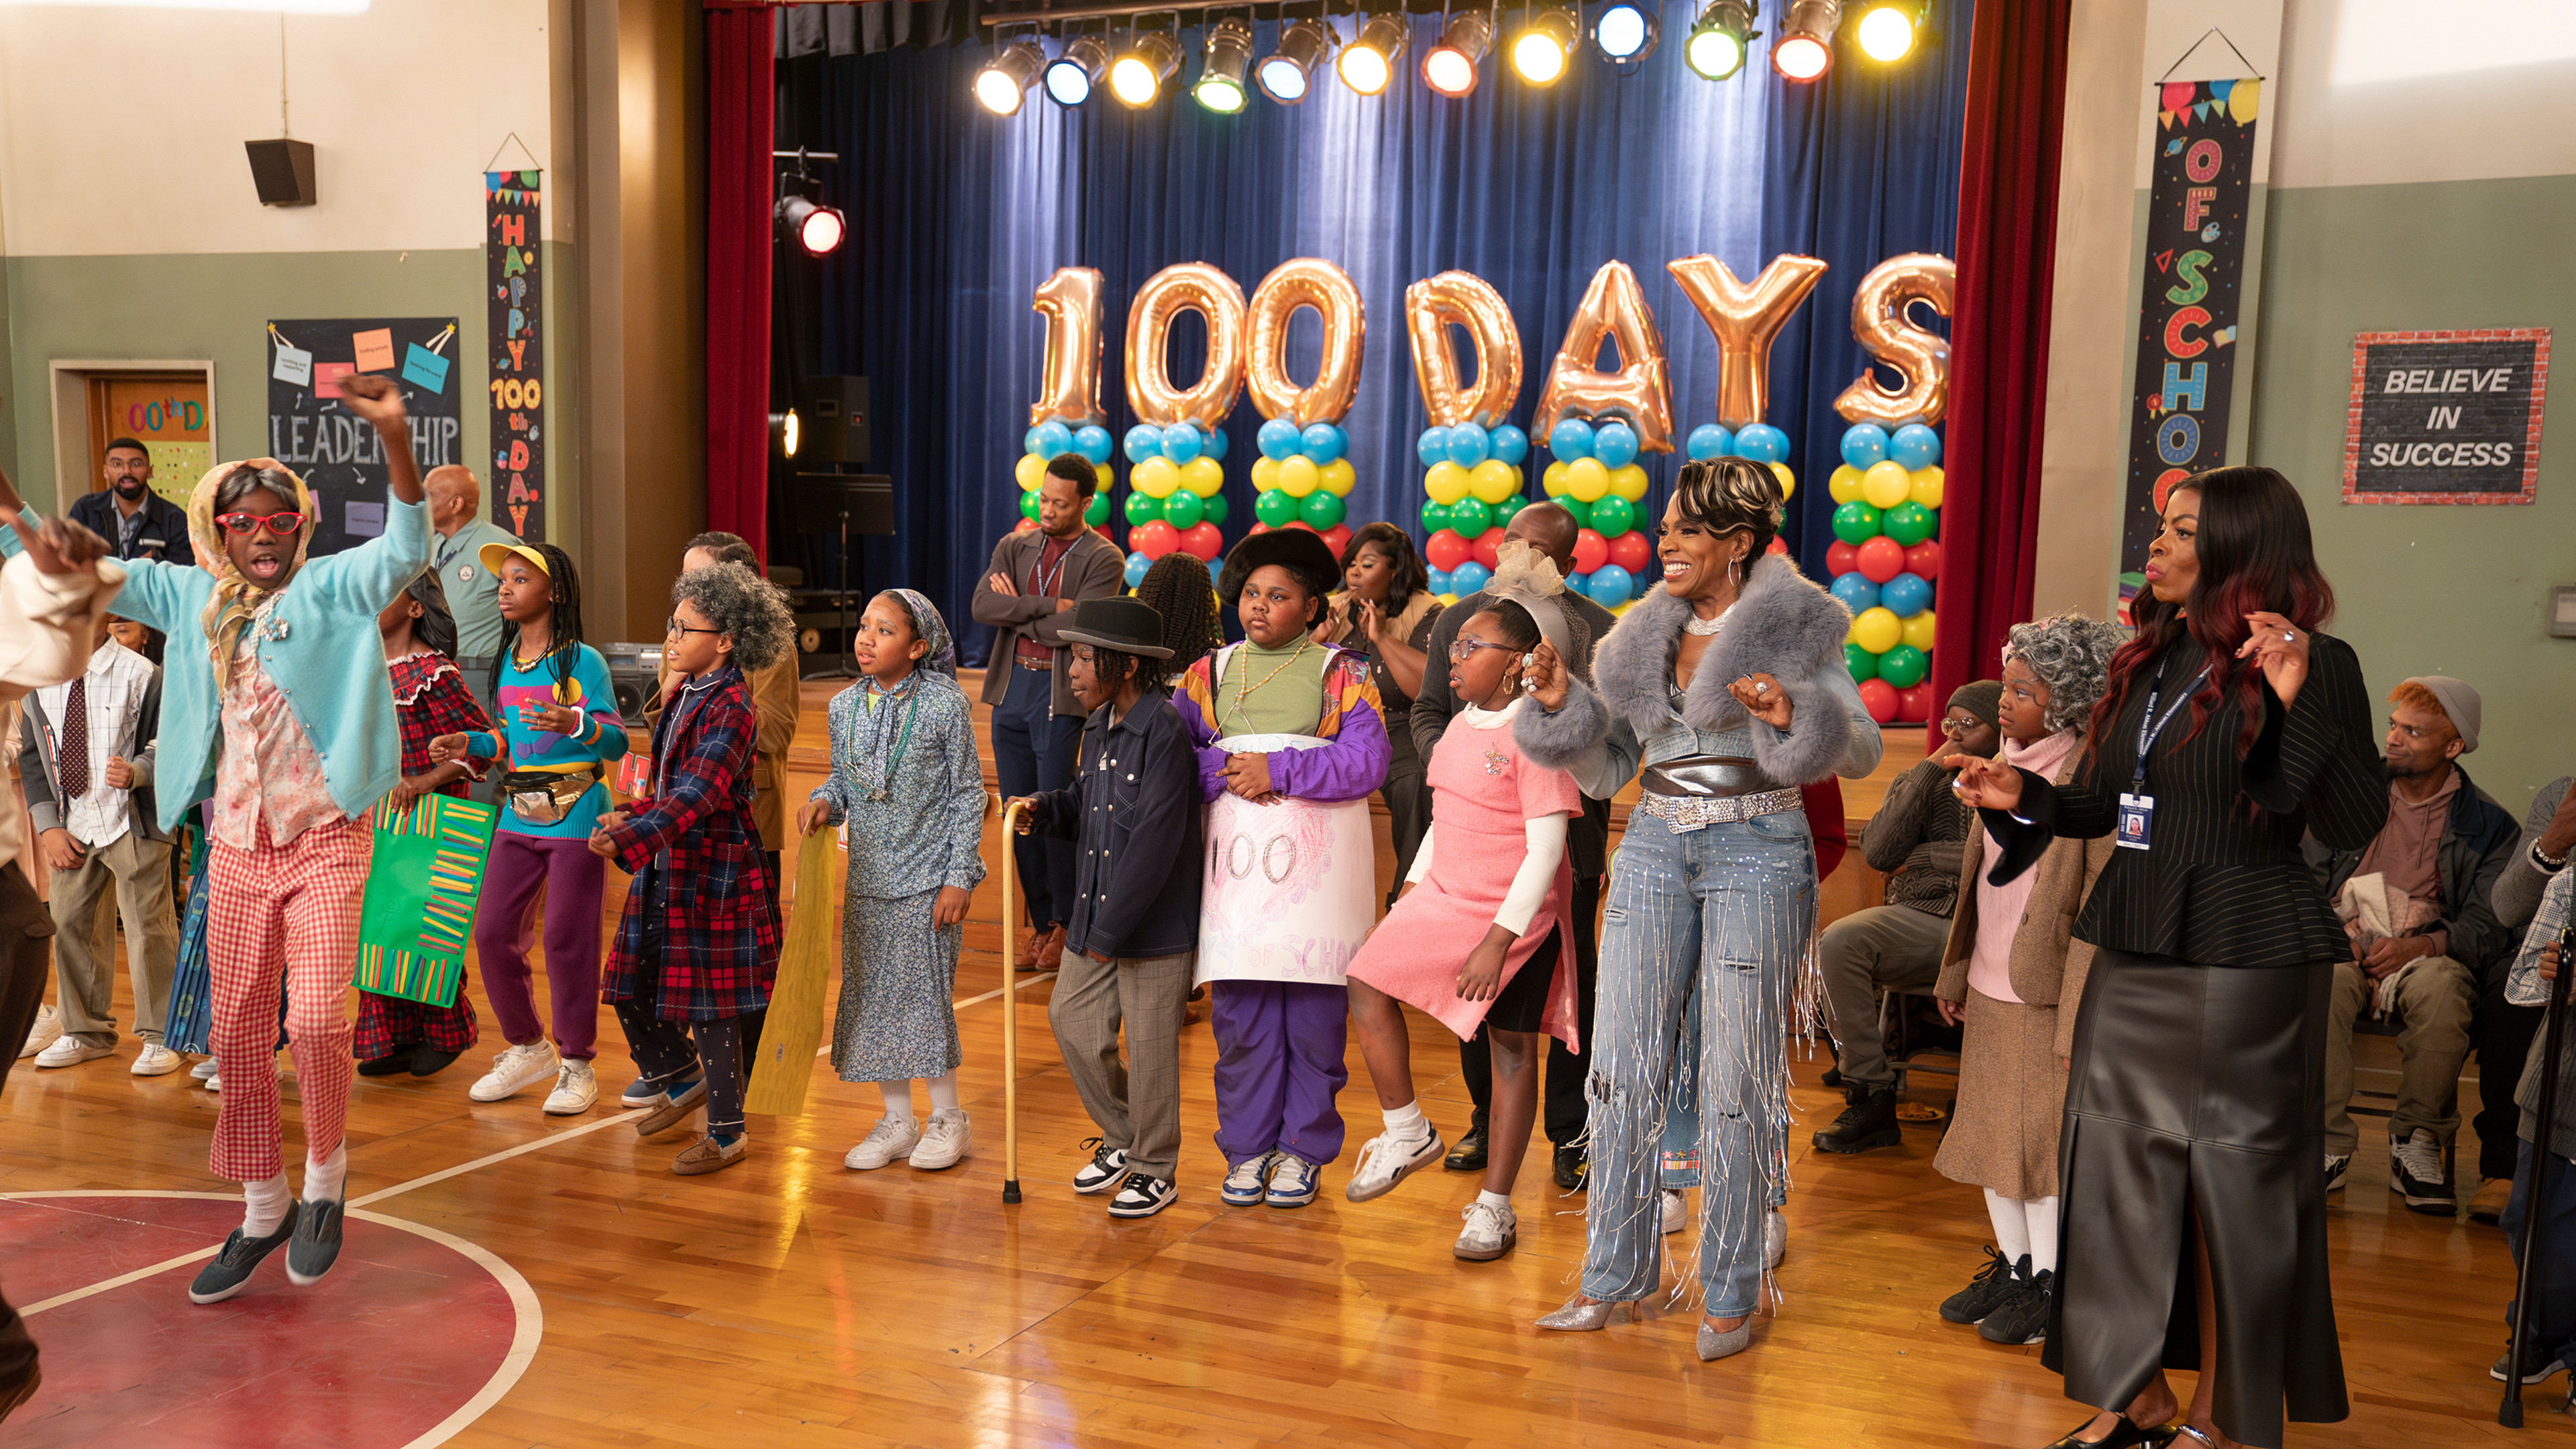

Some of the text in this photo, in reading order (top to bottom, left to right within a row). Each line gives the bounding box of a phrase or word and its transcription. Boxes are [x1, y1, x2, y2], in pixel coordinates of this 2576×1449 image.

[2184, 138, 2222, 231] OF
[490, 213, 541, 537] HAPPY 100 th DAY
[1030, 252, 1957, 455] 100 DAYS
[2383, 368, 2513, 394] BELIEVE
[183, 400, 209, 431] D
[2426, 406, 2462, 430] IN
[270, 414, 460, 466] LEADERHIP
[2369, 441, 2514, 466] SUCCESS
[1211, 831, 1297, 885] 100
[1195, 934, 1364, 979] YS OF SCHO
